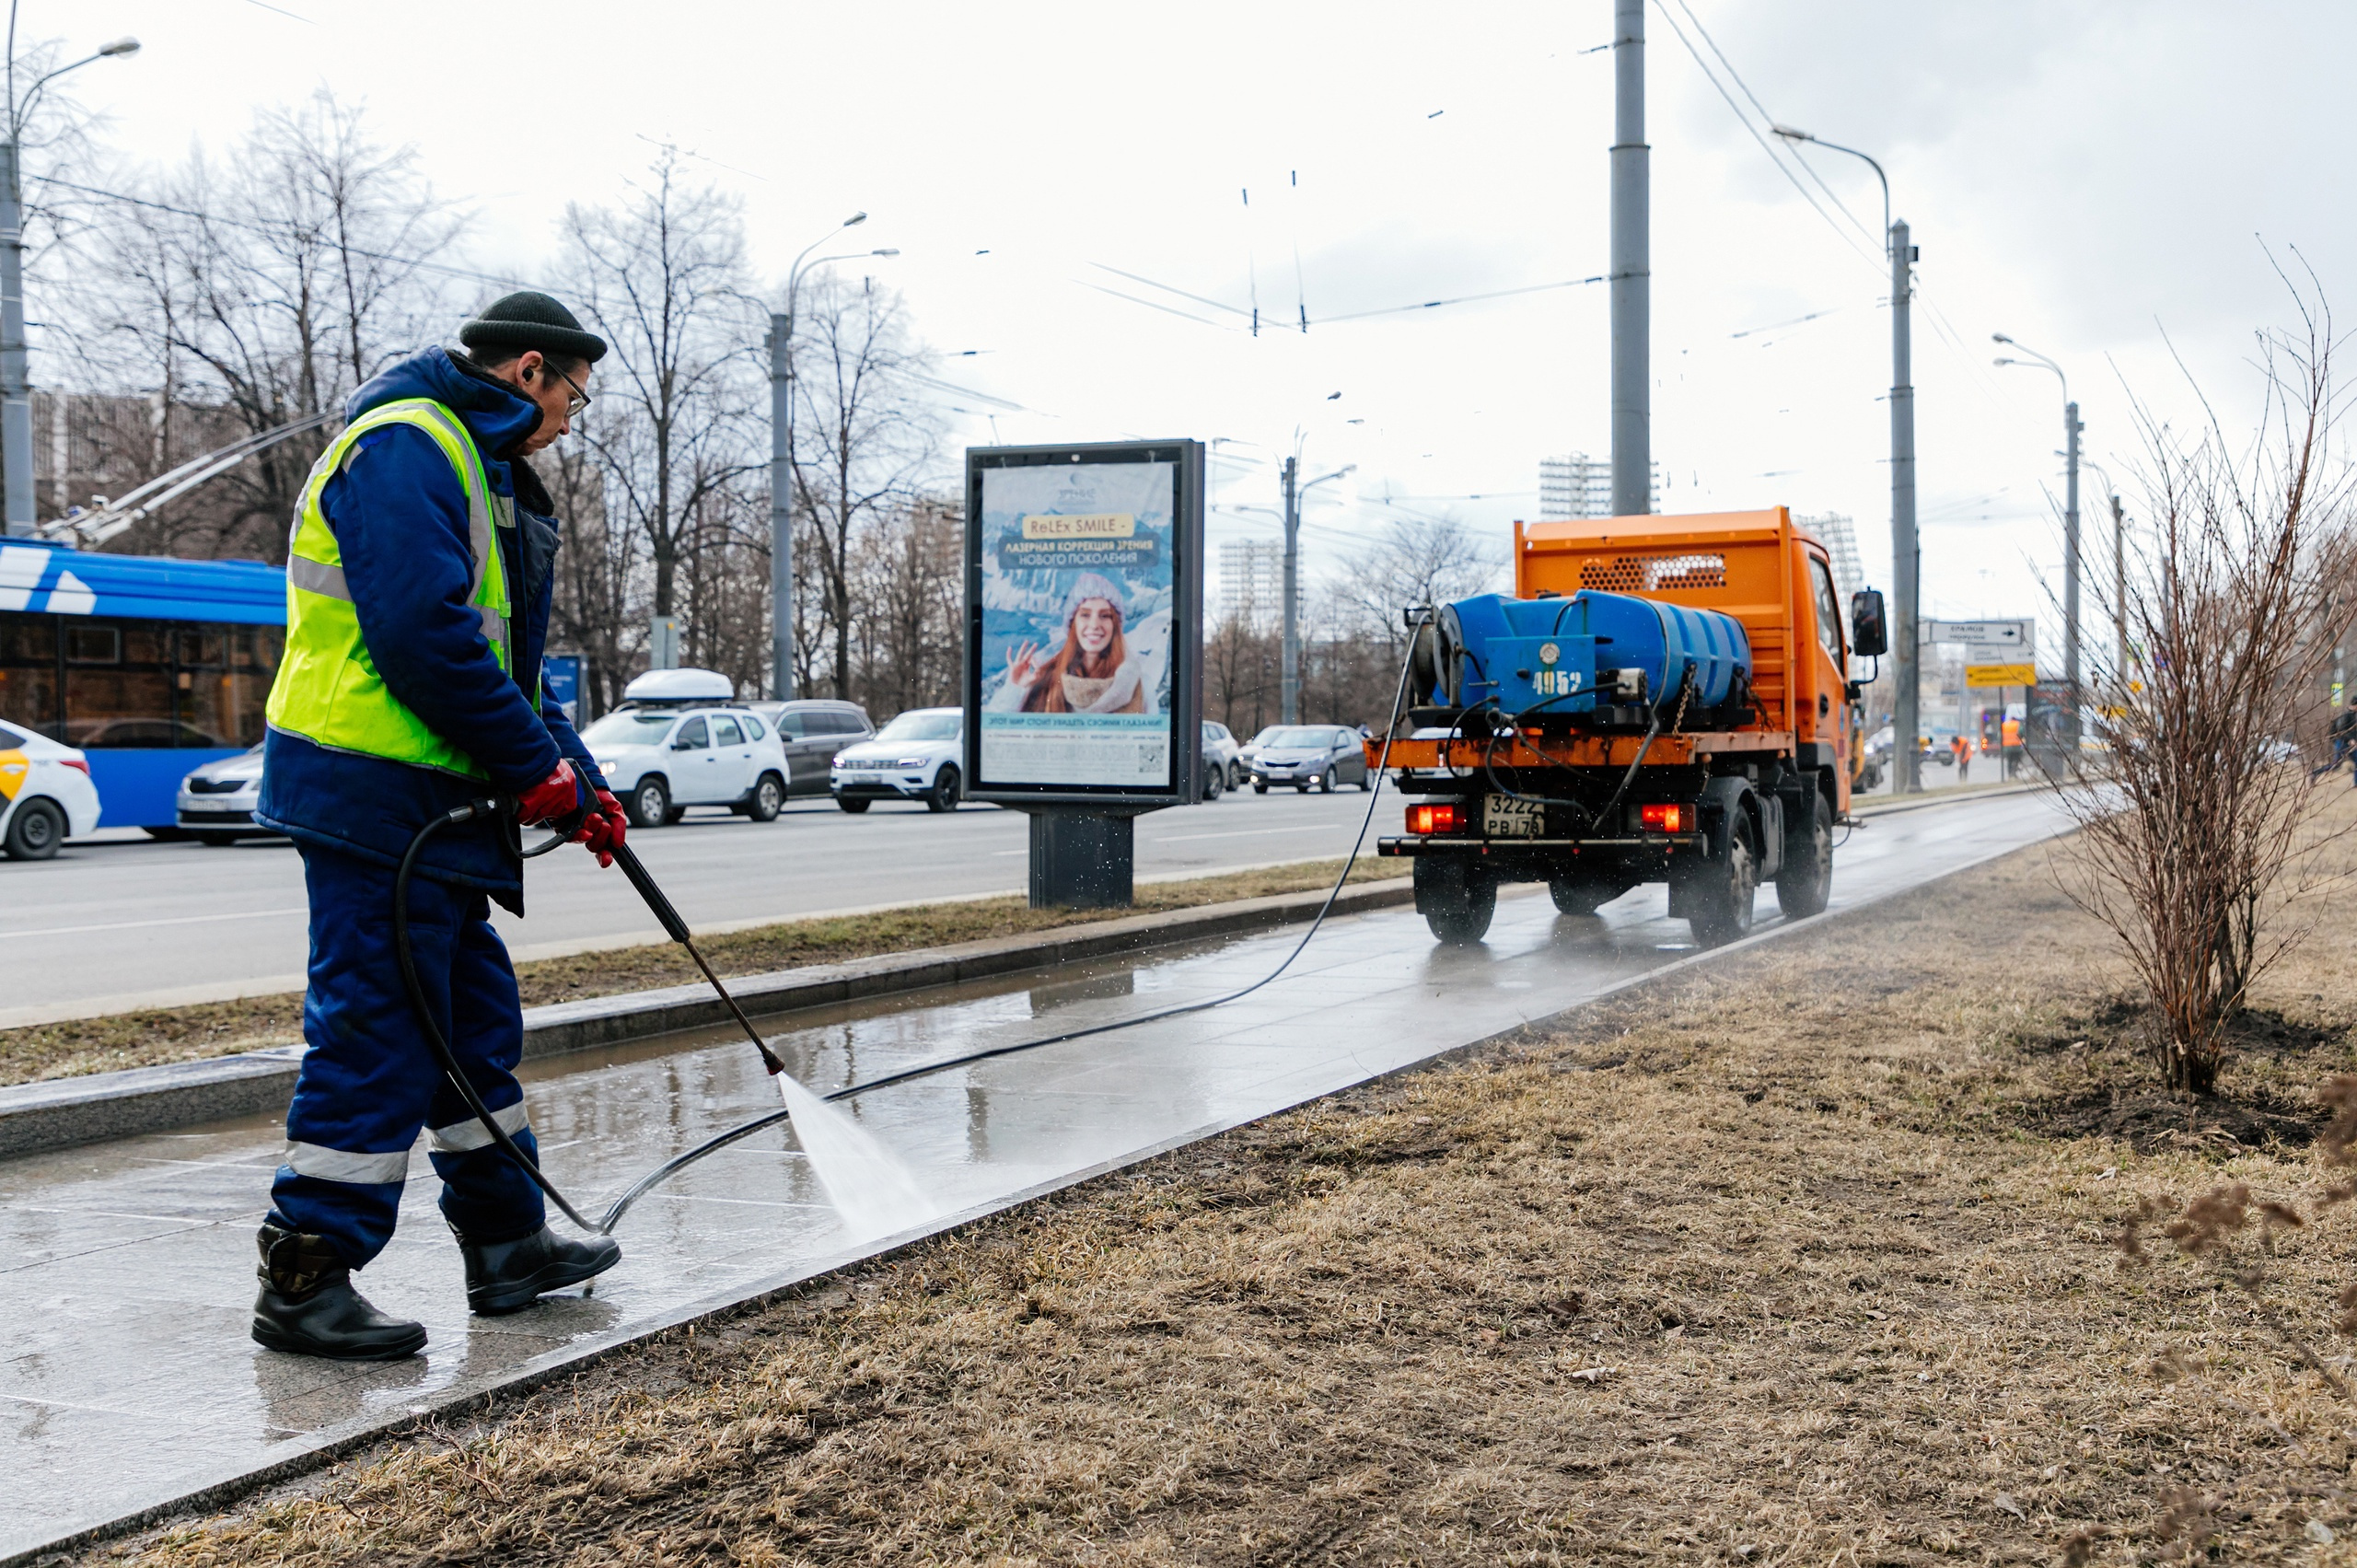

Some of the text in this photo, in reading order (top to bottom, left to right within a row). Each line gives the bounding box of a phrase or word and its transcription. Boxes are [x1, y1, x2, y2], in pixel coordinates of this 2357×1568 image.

[1030, 519, 1071, 534] ReLEx
[1076, 518, 1117, 533] SMILE
[1004, 540, 1154, 553] ЛАЗЕРНАЯ КОРРЕКЦИЯ ЗРЕНИЯ
[1019, 552, 1138, 565] НОВОГО ПОКОЛЕНИЯ
[1532, 670, 1582, 696] 4952
[1492, 796, 1537, 814] 3222
